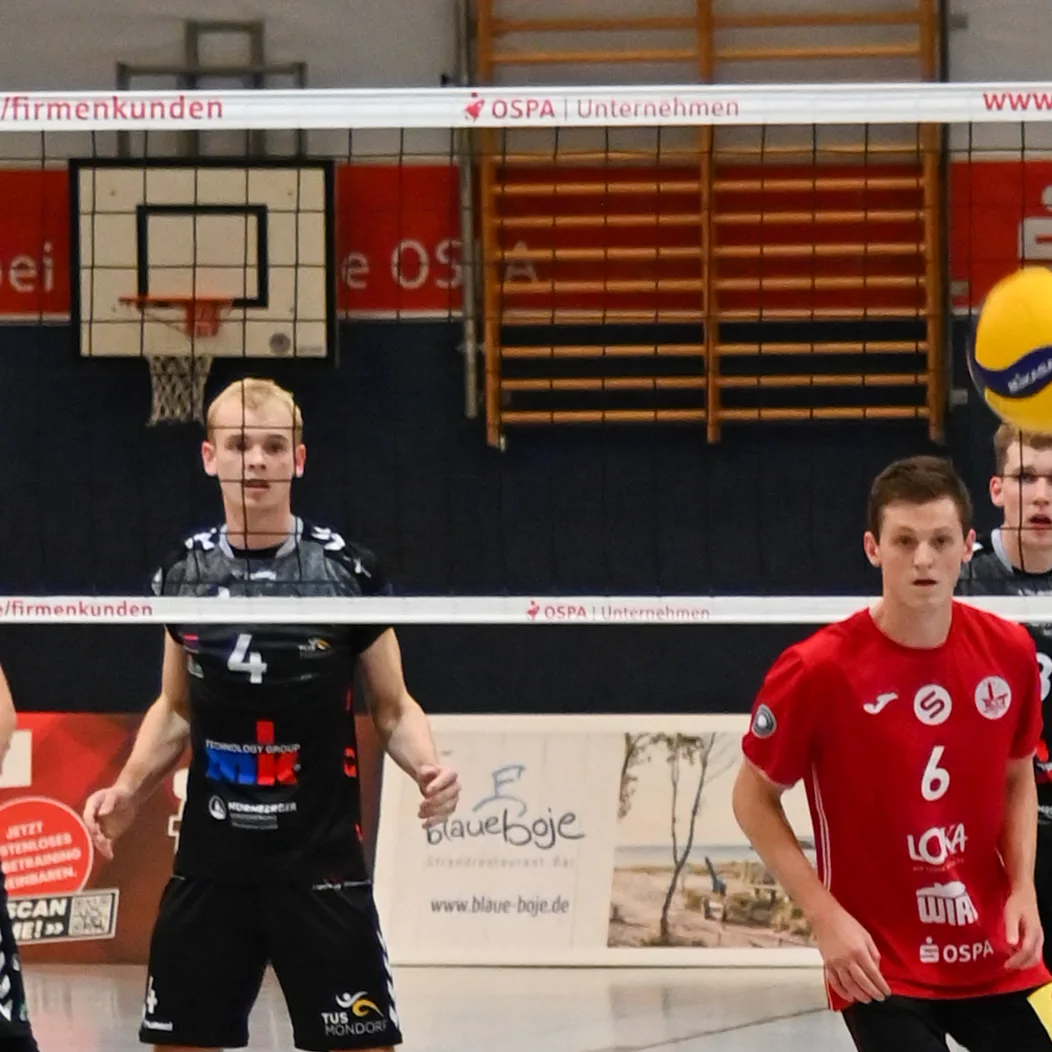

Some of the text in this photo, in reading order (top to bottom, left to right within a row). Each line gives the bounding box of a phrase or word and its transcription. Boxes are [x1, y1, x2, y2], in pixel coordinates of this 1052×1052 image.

[1, 95, 223, 120] /firmenkunden
[491, 97, 739, 119] OSPA Unternehmen
[544, 604, 710, 619] OSPA Unternehmen
[227, 634, 268, 684] 4
[920, 745, 951, 802] 6
[906, 823, 968, 865] LOKA
[430, 895, 570, 917] www.blaue-boje.de
[943, 940, 994, 963] OSPA
[321, 1012, 349, 1025] TUS
[325, 1019, 388, 1037] MONDORF
